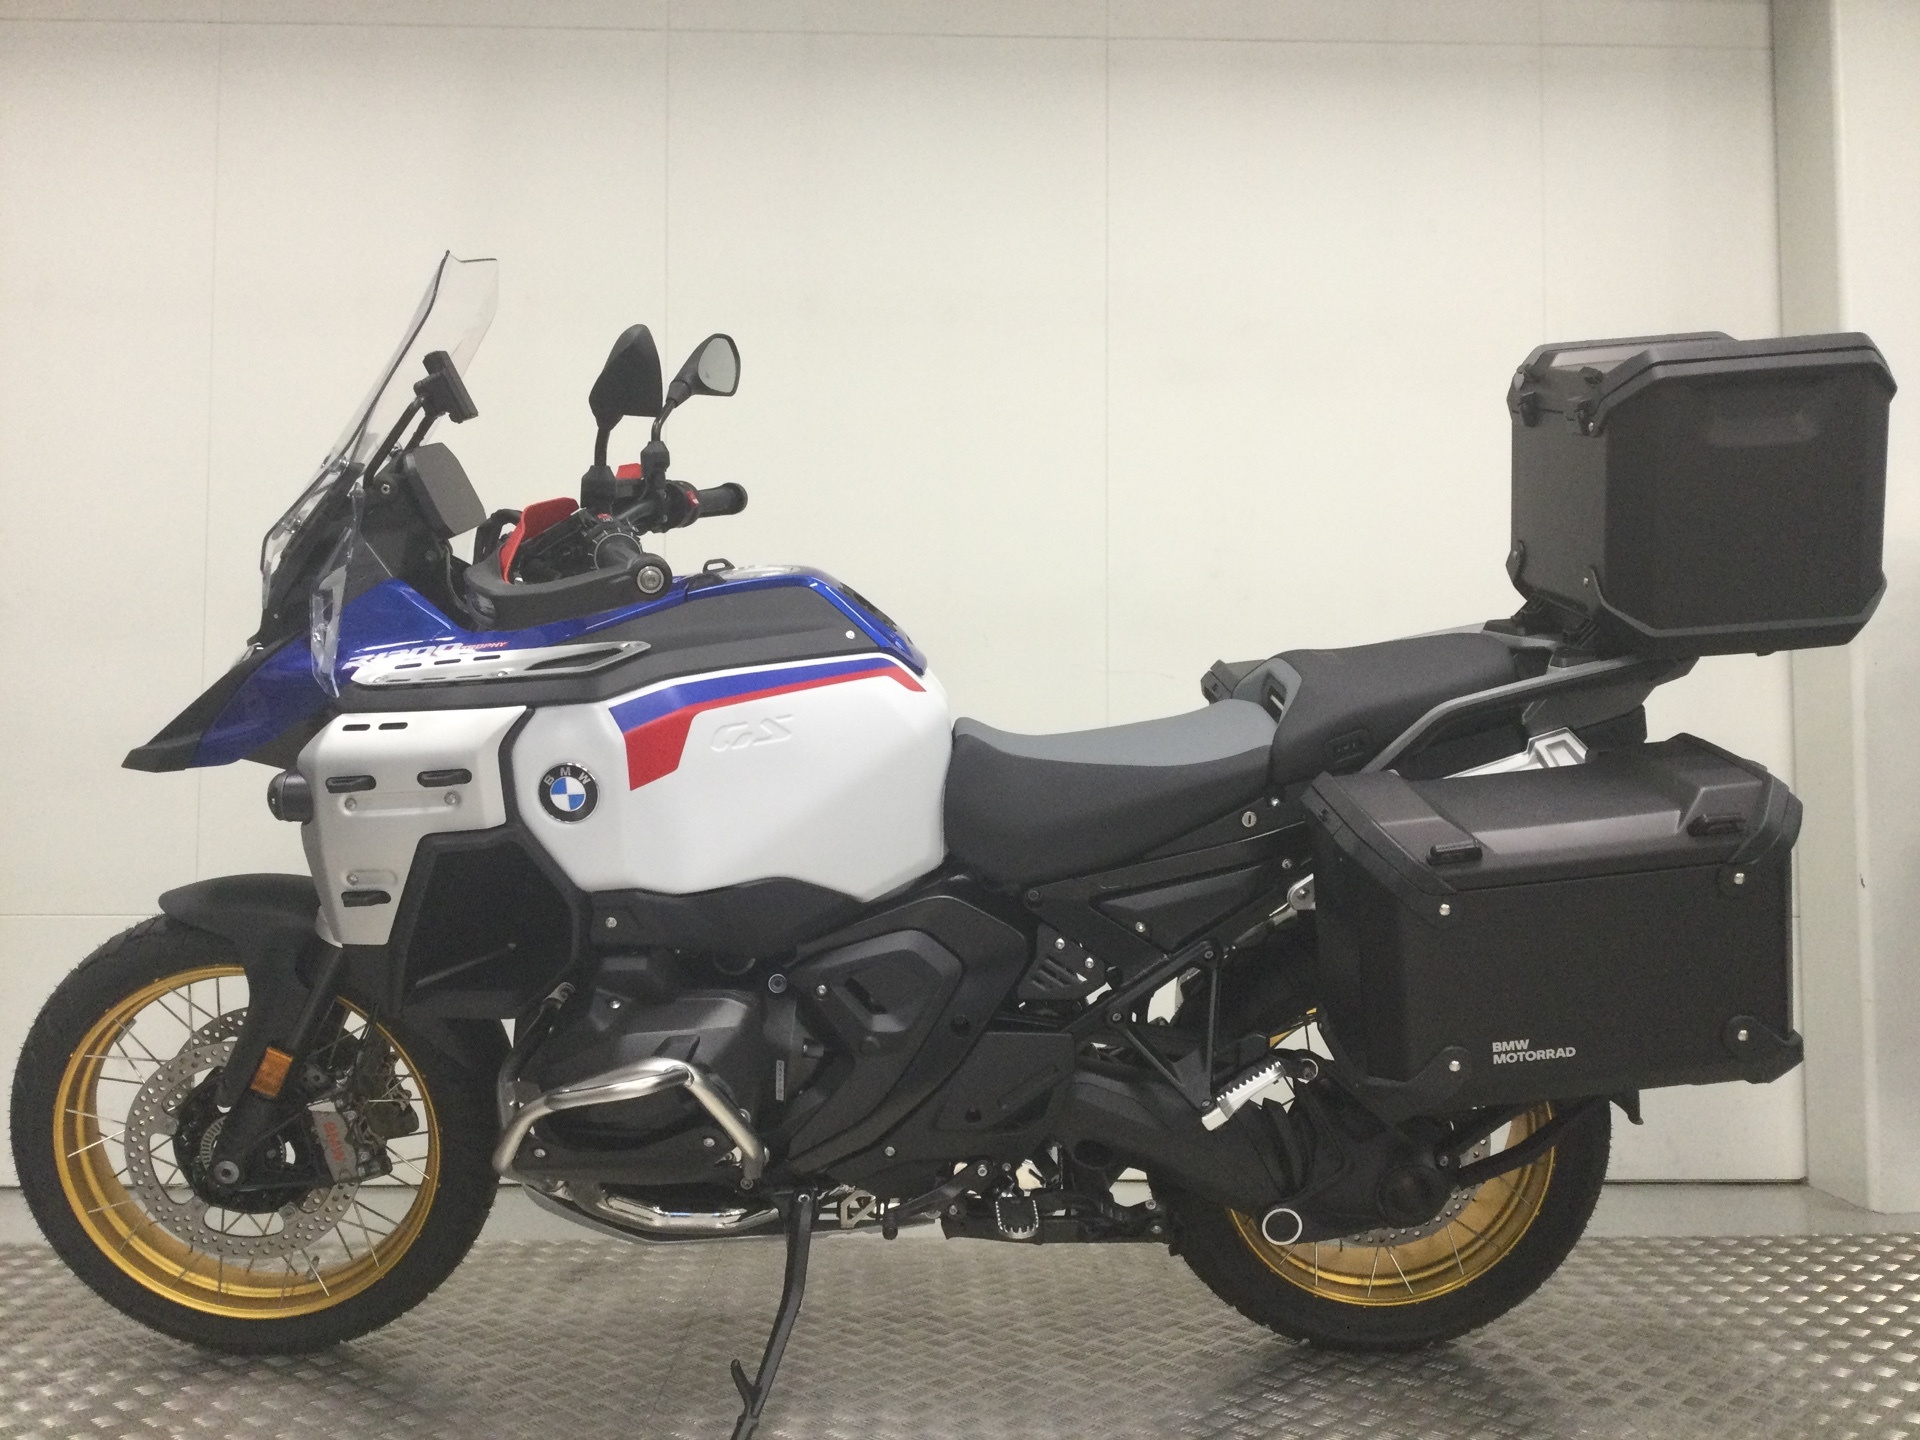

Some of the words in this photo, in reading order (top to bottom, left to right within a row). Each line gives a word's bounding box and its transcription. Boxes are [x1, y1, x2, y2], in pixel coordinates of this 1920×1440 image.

[711, 714, 793, 752] GS
[543, 766, 591, 786] BMW
[1492, 1039, 1530, 1053] BMW
[1493, 1047, 1576, 1065] MOTORRAD
